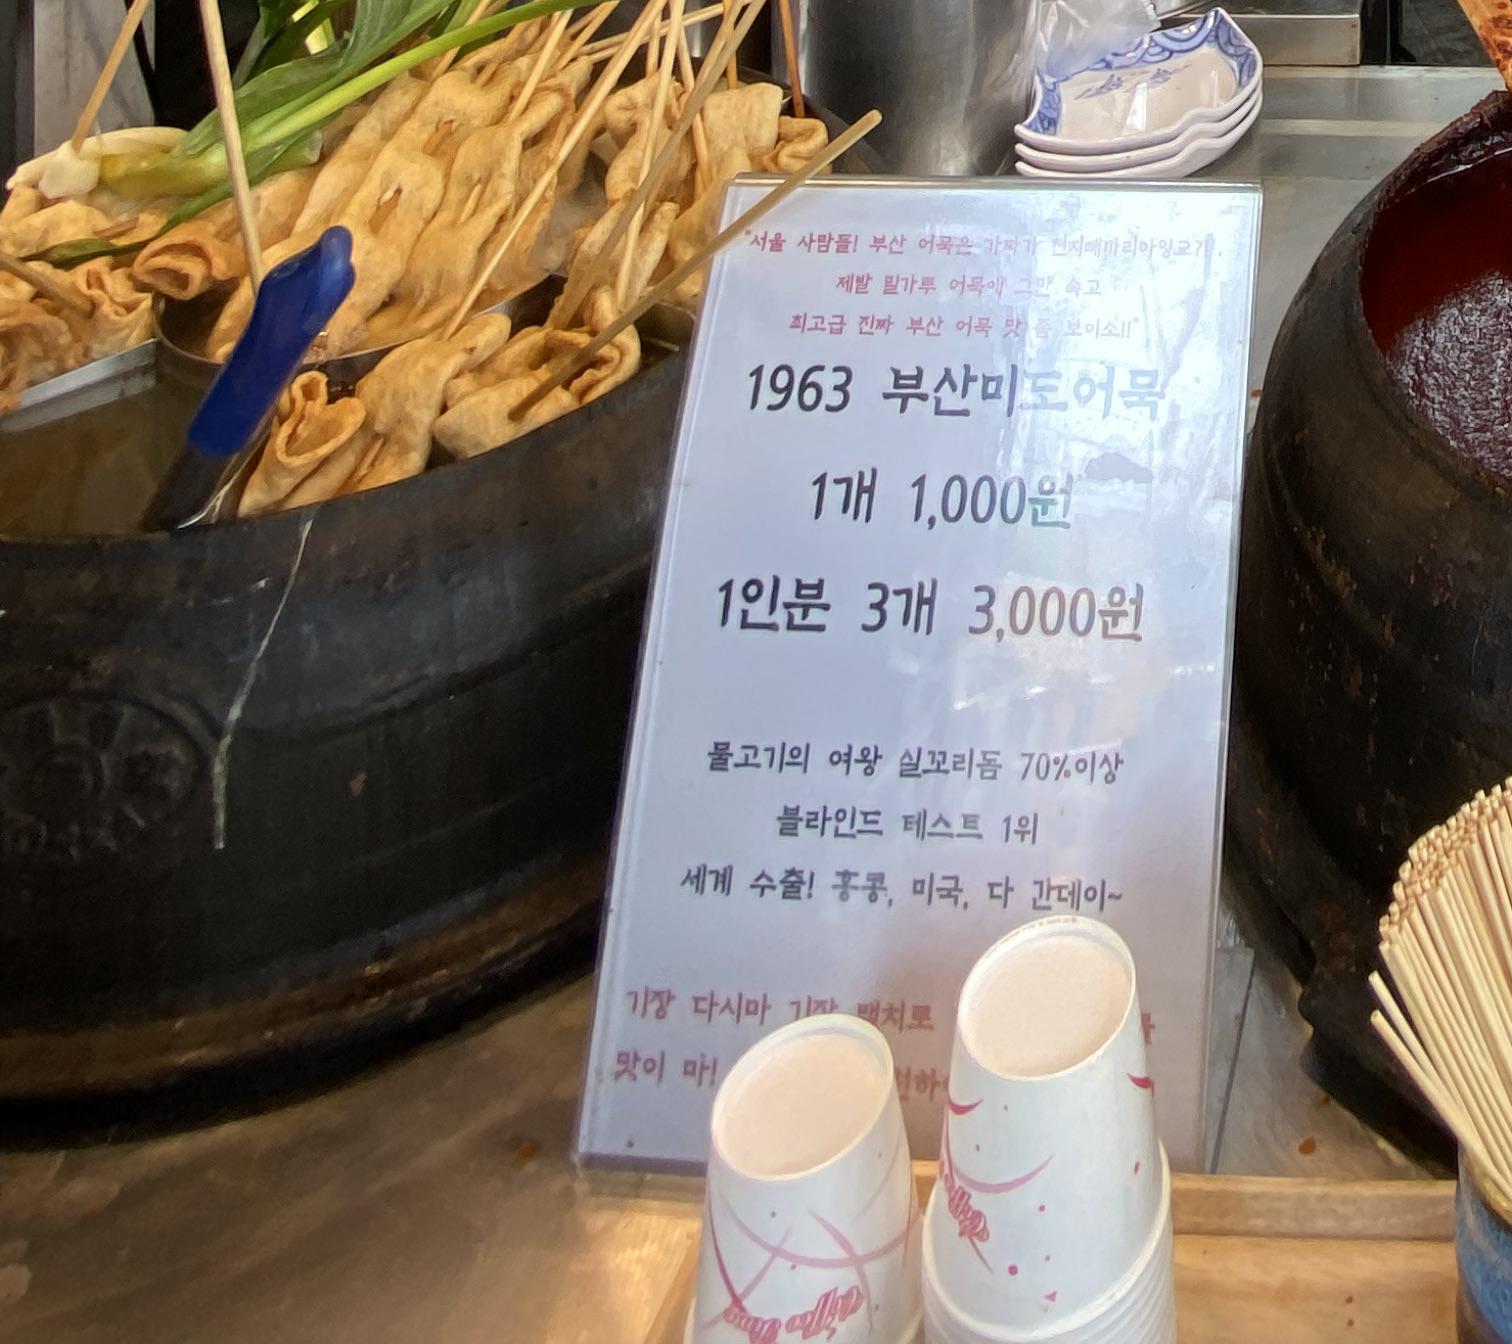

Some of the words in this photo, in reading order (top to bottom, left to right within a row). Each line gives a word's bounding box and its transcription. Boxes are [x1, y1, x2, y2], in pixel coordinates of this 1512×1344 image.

[797, 232, 858, 254] 사람들!
[869, 233, 907, 255] 부산
[918, 234, 974, 256] 어묵은
[836, 273, 872, 295] 제발
[949, 275, 1005, 296] 어묵에
[789, 313, 847, 335] 최고급
[858, 315, 894, 336] 진짜
[906, 316, 944, 337] 부산
[956, 316, 992, 338] 어묵
[1003, 316, 1023, 339] 맛
[746, 362, 855, 413] 1963
[882, 362, 1167, 421] 부산미도어묵
[811, 467, 878, 525] 1개
[910, 472, 1073, 534] 1,000원
[716, 576, 832, 634] 1인분
[861, 577, 939, 638] 3개
[968, 581, 1146, 644] 3,000원
[706, 740, 811, 776] 물고기의
[828, 743, 883, 777] 여왕
[898, 746, 1003, 781] 실꼬리돔
[1019, 750, 1125, 786] 70%이상
[777, 804, 884, 840] 블라인드
[901, 807, 984, 842] 테스트
[1000, 812, 1040, 846] 1위
[680, 864, 733, 897] 세계
[748, 865, 815, 902] 수출!
[831, 868, 894, 907] 홍콩,
[911, 872, 969, 910] 미국,
[987, 876, 1014, 910] 다
[625, 984, 676, 1020] 기장
[692, 990, 770, 1026] 다시마
[612, 1050, 666, 1087] 맛이
[682, 1055, 718, 1088] 마!
